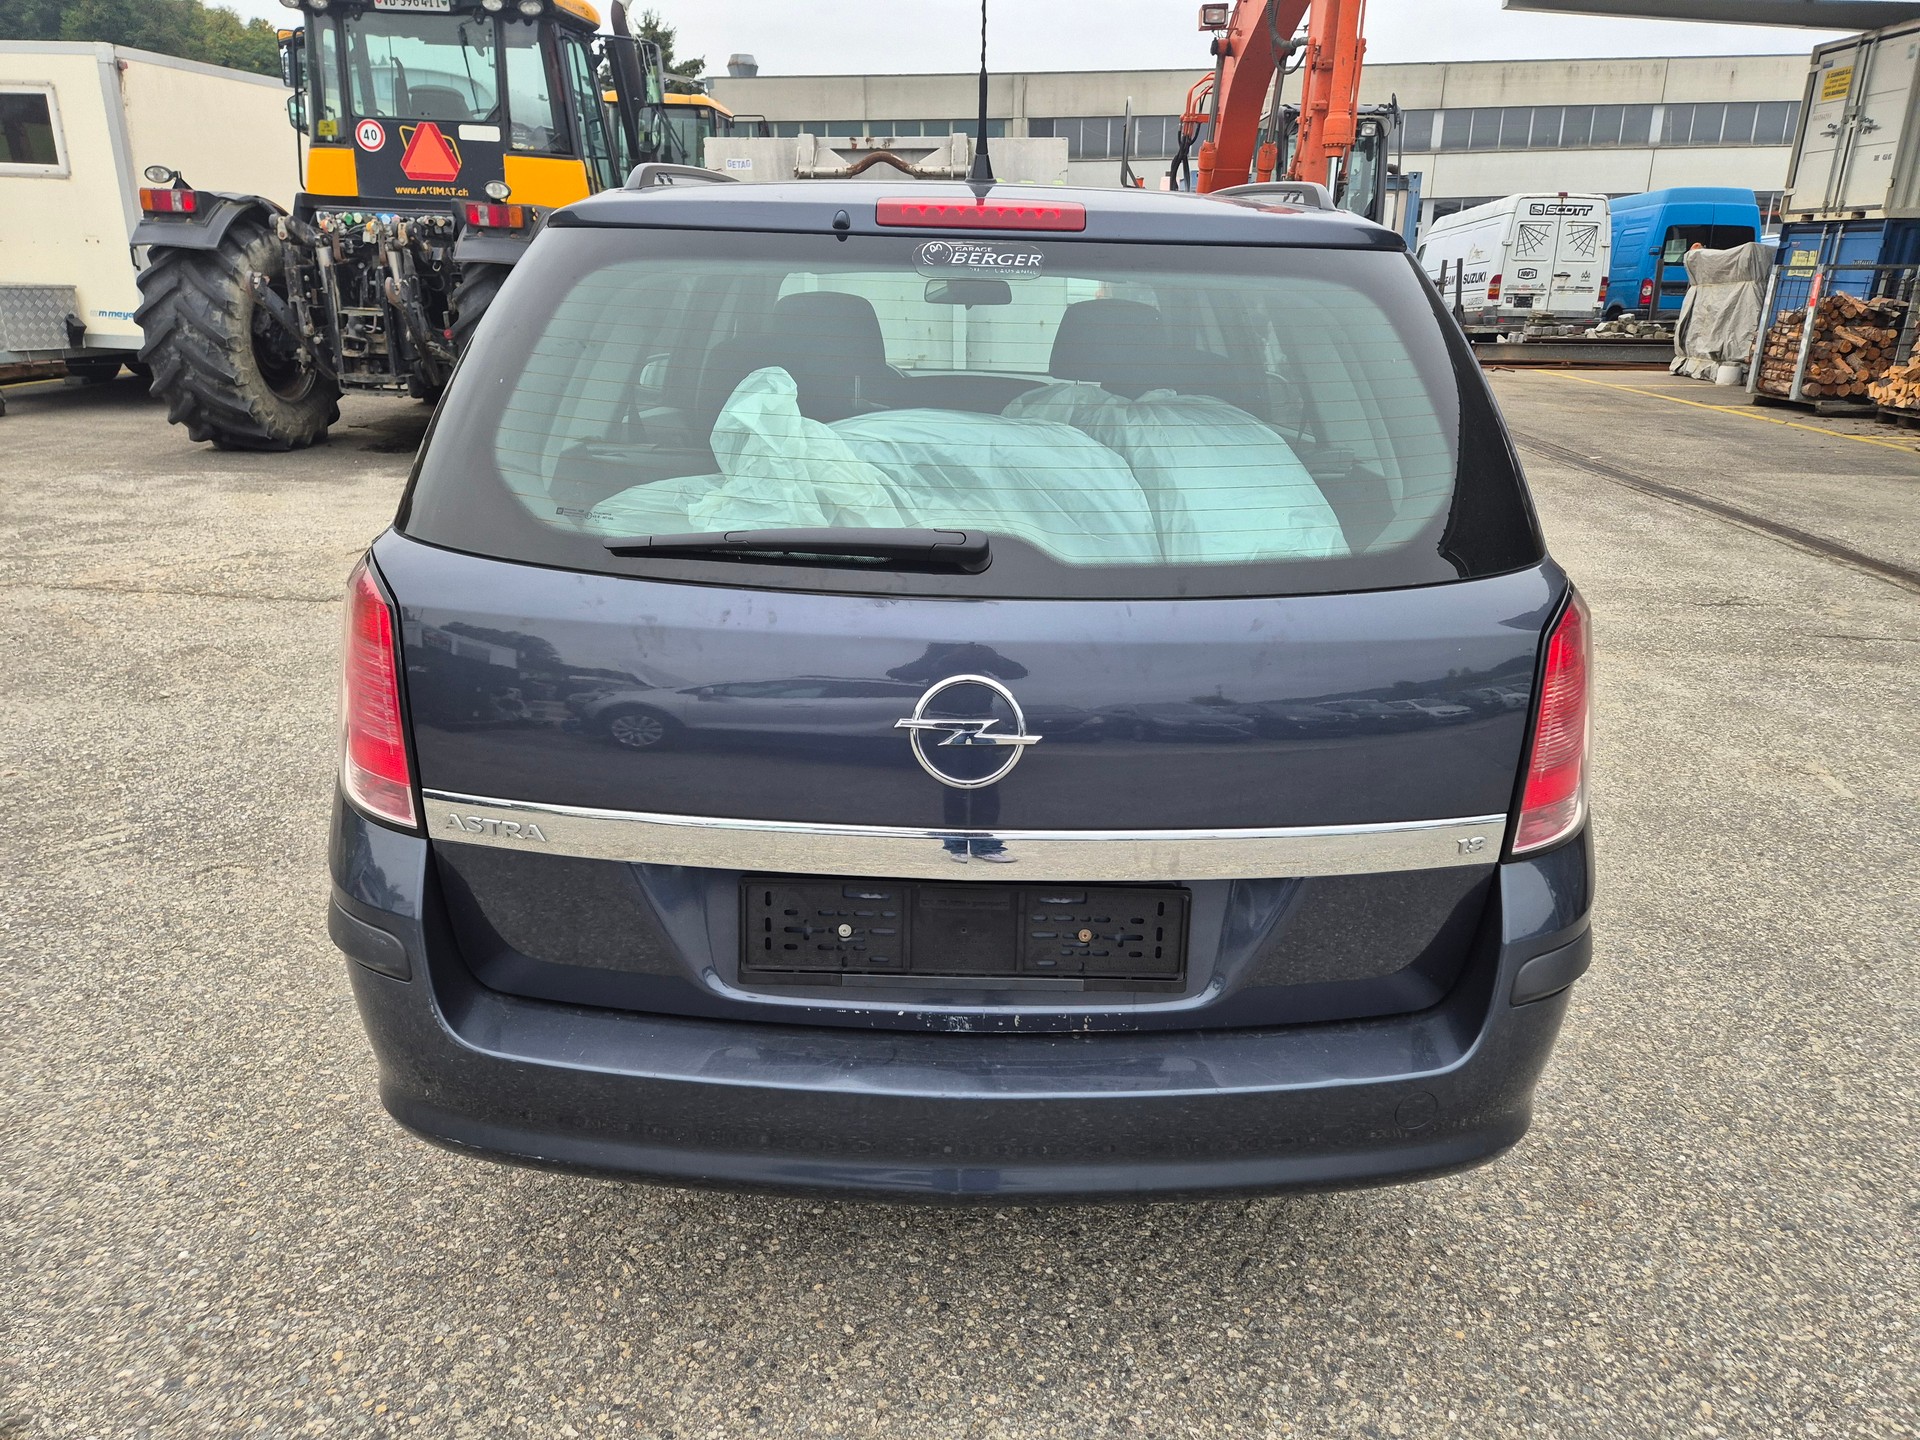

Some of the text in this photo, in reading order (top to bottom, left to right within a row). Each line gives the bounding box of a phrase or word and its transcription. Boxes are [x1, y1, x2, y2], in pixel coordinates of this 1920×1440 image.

[363, 129, 377, 140] 40
[1545, 204, 1593, 216] SCOTT
[951, 252, 1042, 267] BERGER
[1462, 271, 1487, 285] SUZUKI
[1520, 270, 1535, 278] 100%
[108, 311, 134, 320] meye
[446, 813, 546, 842] ASTRA
